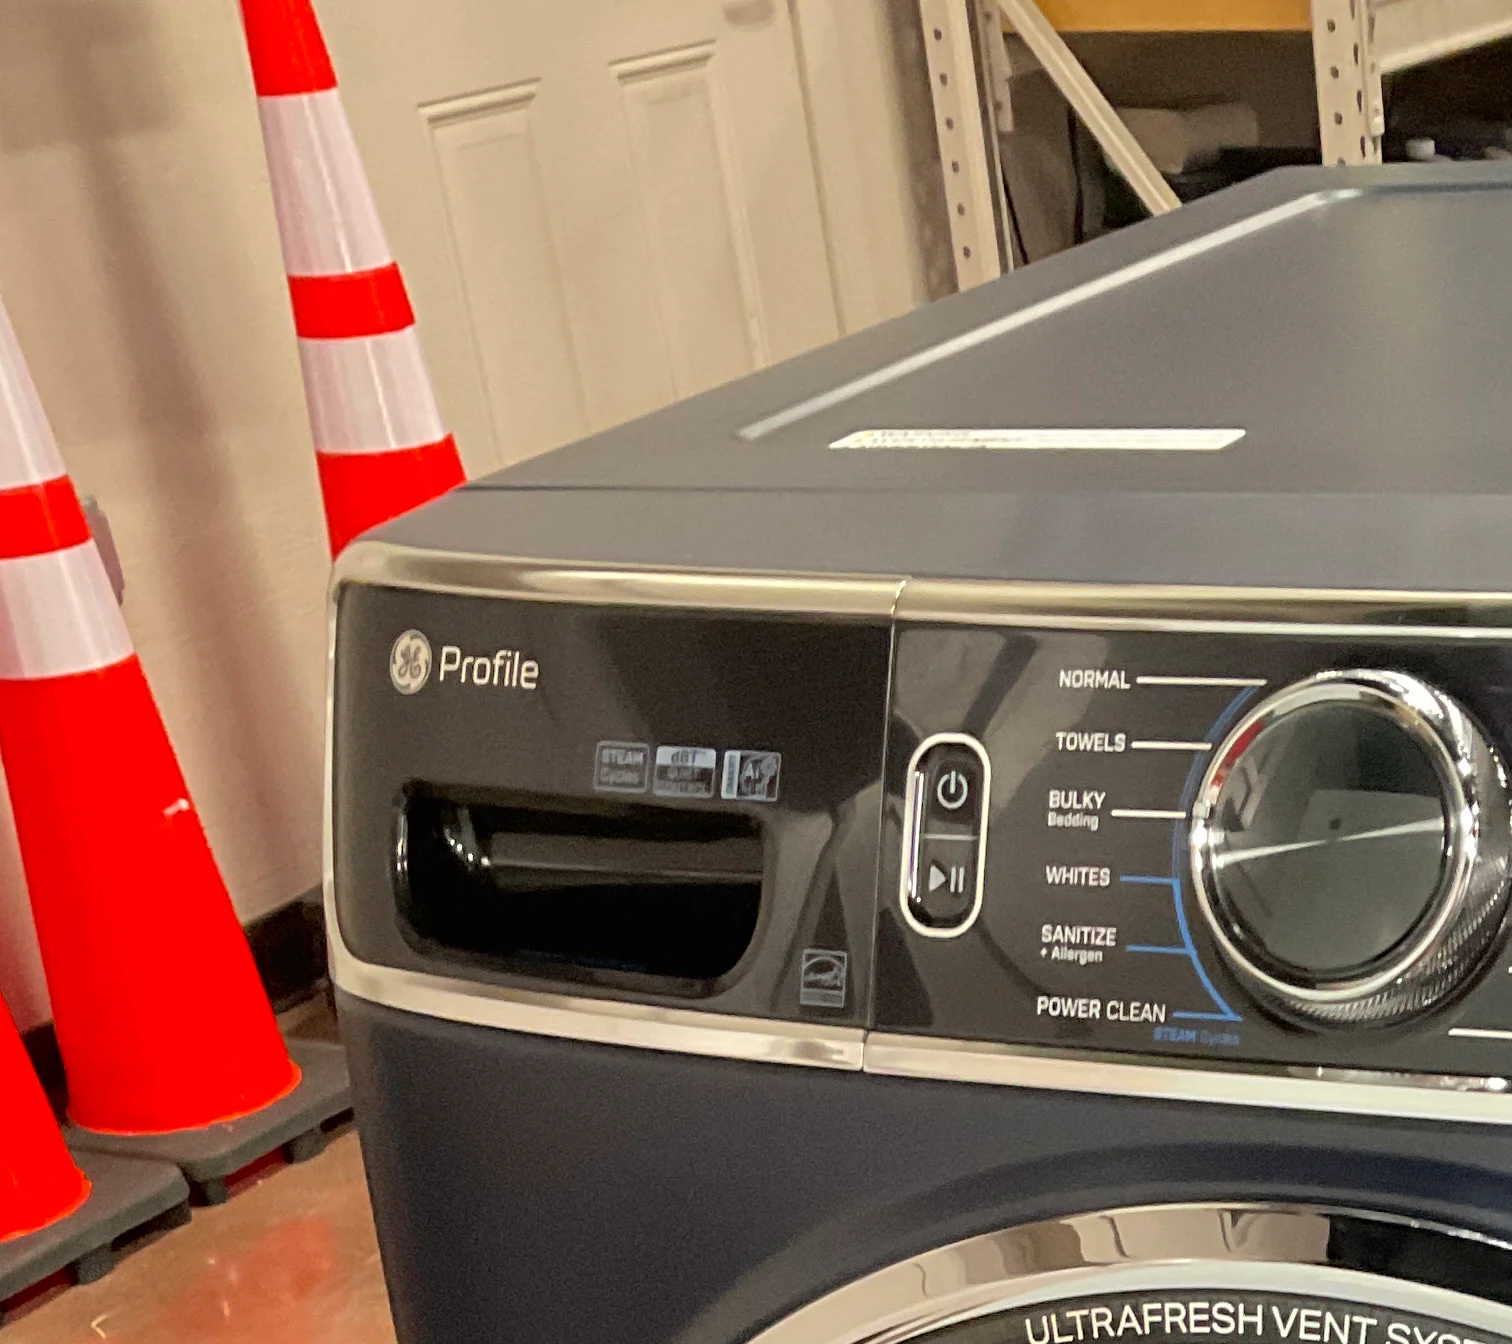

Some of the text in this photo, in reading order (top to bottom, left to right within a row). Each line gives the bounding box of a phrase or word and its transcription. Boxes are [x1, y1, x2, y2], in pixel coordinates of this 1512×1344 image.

[439, 644, 540, 690] Profile
[1059, 669, 1130, 689] NORMAL
[1055, 732, 1126, 752] TOWELS
[1048, 789, 1106, 810] BULKY
[1047, 812, 1099, 831] Bedding
[1045, 865, 1111, 886] WHITES
[1041, 924, 1117, 946] SANITIZE
[1051, 946, 1103, 966] Allergen
[1036, 996, 1166, 1023] POWER CLEAN
